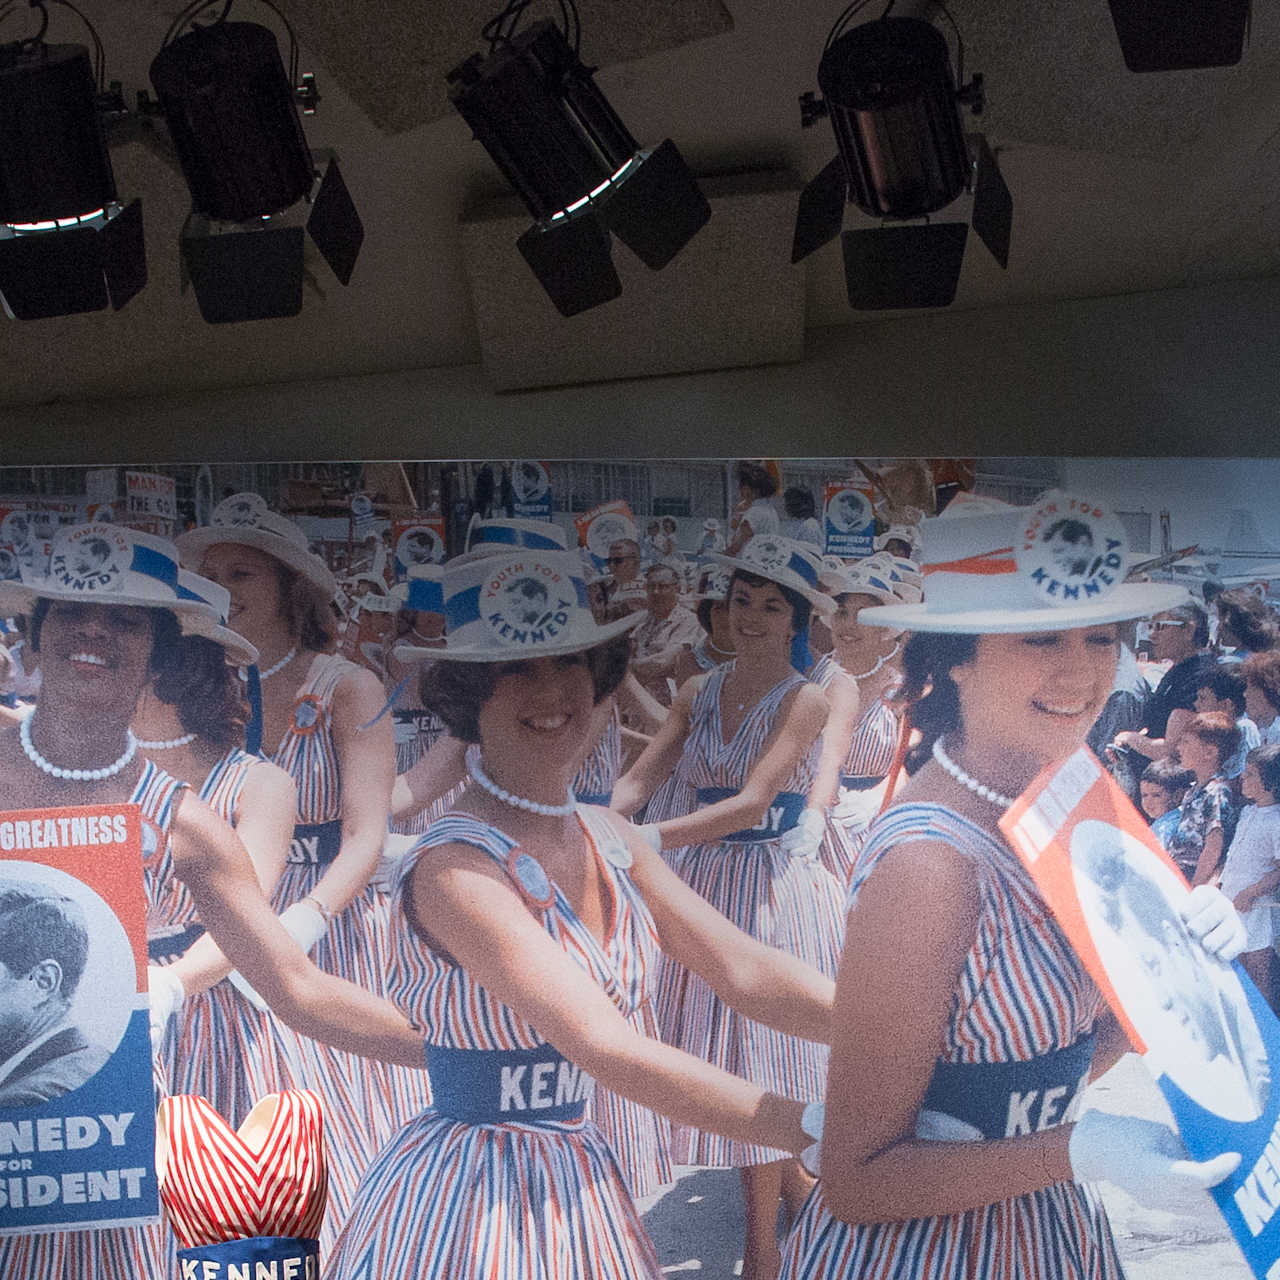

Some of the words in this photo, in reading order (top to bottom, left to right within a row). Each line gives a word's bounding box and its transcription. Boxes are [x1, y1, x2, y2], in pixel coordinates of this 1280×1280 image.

[54, 555, 120, 590] KENNEDY
[1031, 537, 1122, 600] KENNEDY
[488, 597, 571, 643] KENNEDY
[0, 815, 127, 851] GREATNESS
[0, 1158, 32, 1172] FOR
